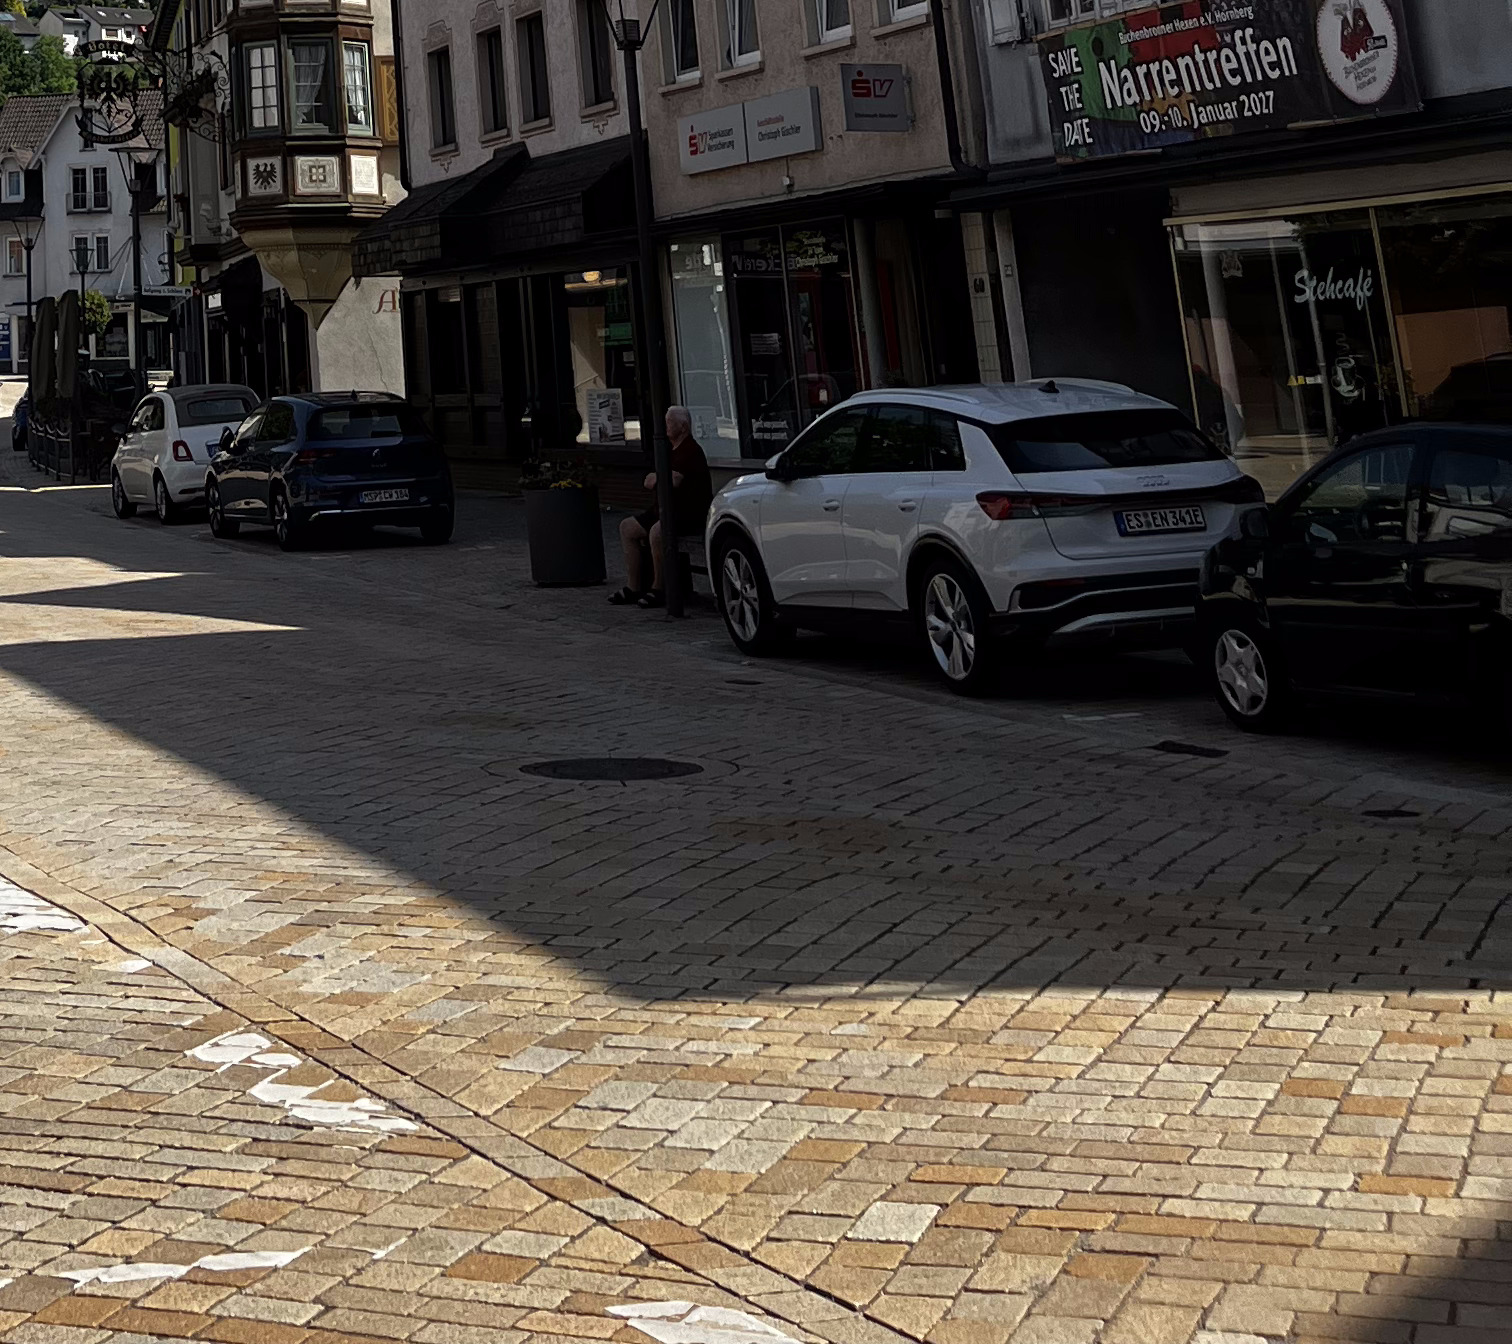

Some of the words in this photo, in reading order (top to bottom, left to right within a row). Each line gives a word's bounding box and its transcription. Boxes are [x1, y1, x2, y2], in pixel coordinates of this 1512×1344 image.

[1173, 17, 1200, 32] Hexen
[1215, 5, 1255, 24] Hornberg
[1048, 47, 1083, 79] SAVE
[1098, 26, 1298, 109] Narrentreffen
[1059, 83, 1083, 112] THE
[1189, 100, 1239, 129] Januar
[1238, 90, 1275, 117] 2027
[1063, 117, 1094, 148] DATE
[1294, 266, 1374, 311] Stehcafé
[1125, 513, 1144, 530] ES
[1150, 510, 1170, 528] EN
[1172, 508, 1204, 526] 341E
